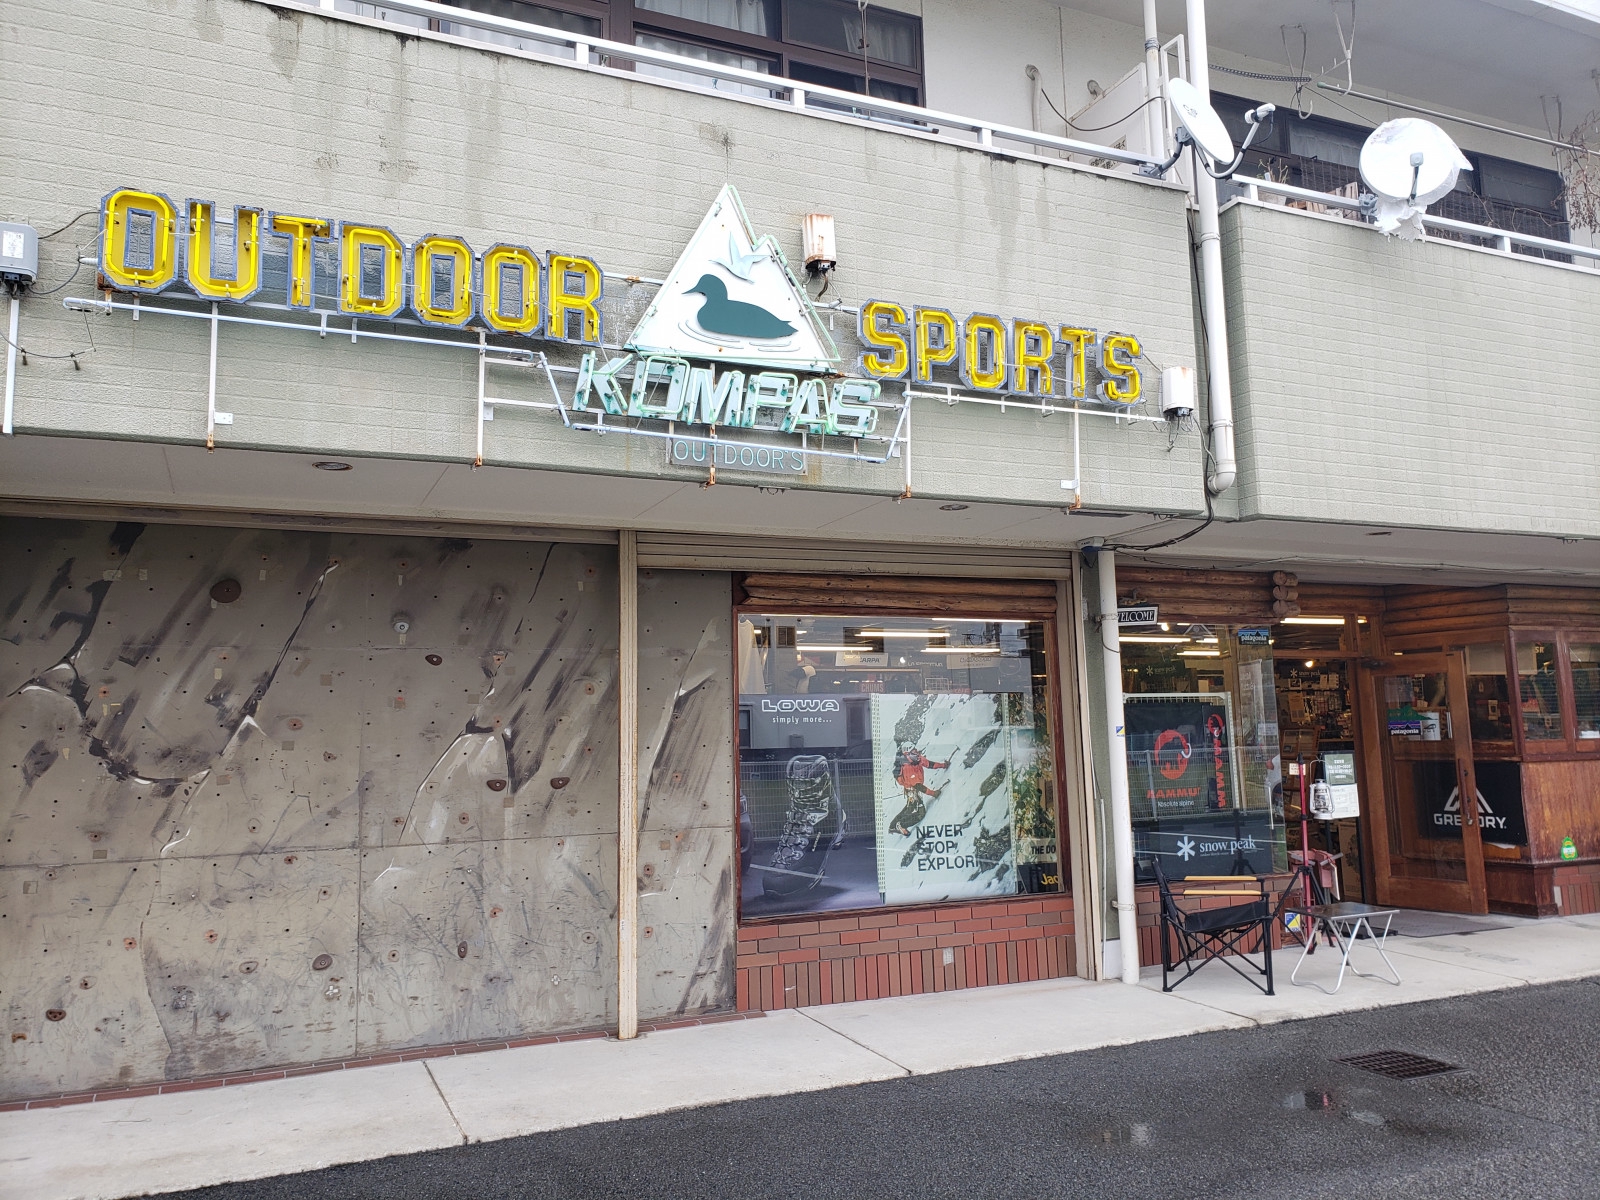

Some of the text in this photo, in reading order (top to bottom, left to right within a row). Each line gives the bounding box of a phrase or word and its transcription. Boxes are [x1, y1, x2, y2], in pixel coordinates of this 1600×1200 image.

[100, 186, 605, 345] OUTDOOR
[858, 298, 1143, 406] SPORTS
[572, 350, 881, 437] KOMPAS
[861, 683, 884, 693] CHUMS
[761, 699, 840, 712] LOWA
[772, 716, 800, 725] simply
[1433, 813, 1507, 829] GREORY
[916, 824, 963, 839] NEVER
[917, 840, 955, 855] STOP
[1031, 845, 1045, 855] THE
[1199, 834, 1256, 855] snow peak
